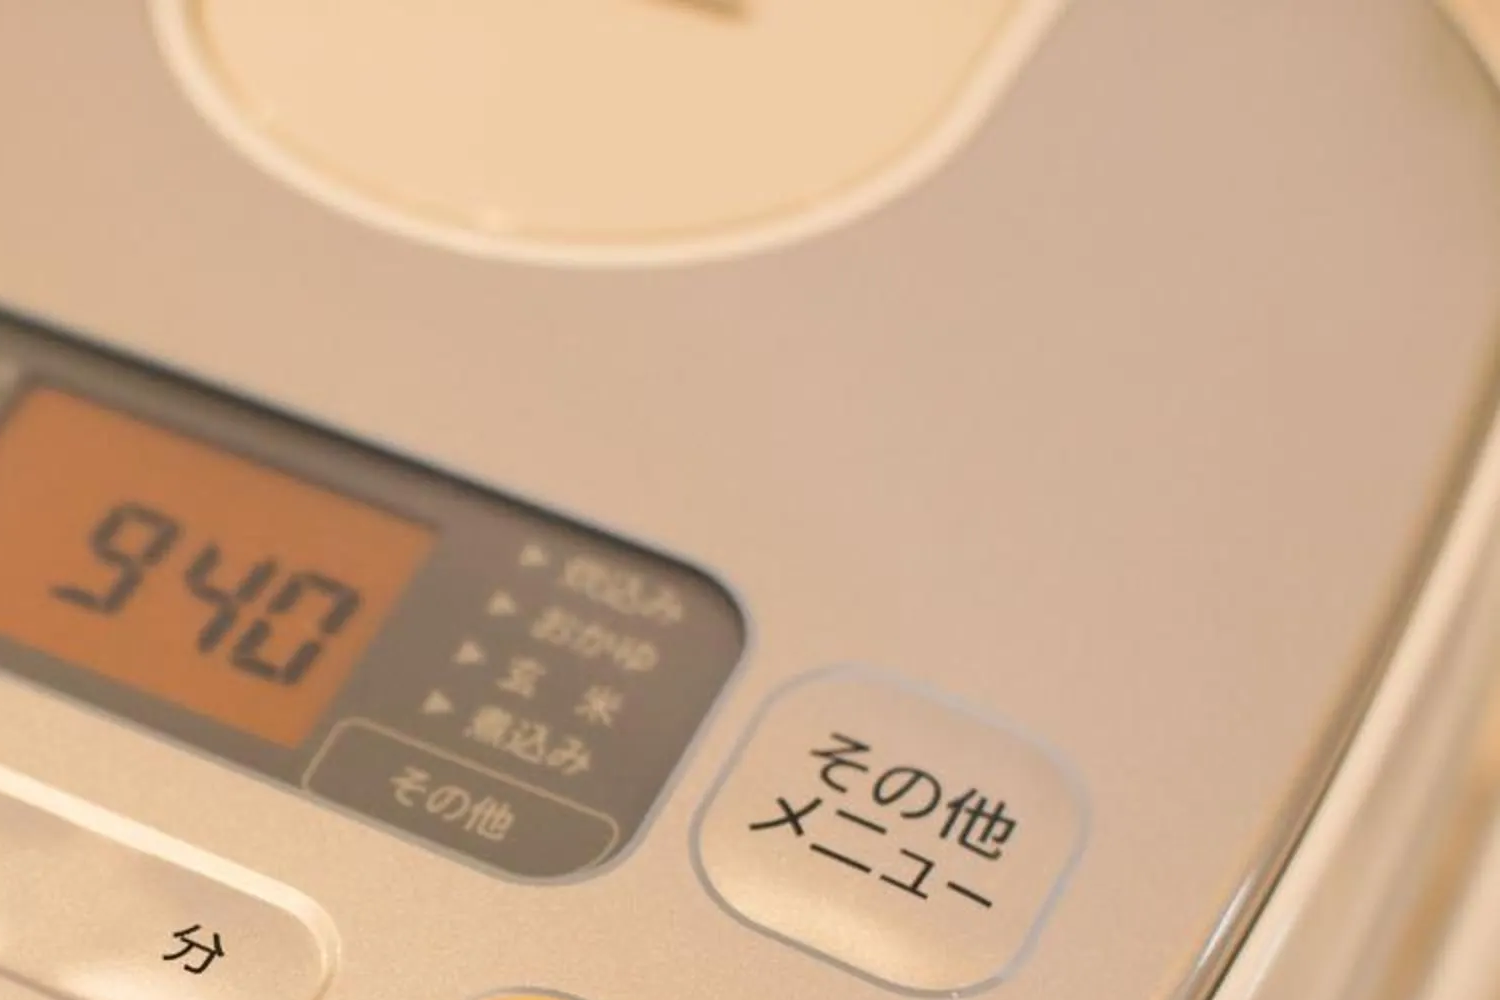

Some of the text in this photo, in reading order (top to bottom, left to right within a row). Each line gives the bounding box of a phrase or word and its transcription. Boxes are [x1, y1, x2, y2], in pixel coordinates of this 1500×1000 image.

[49, 501, 361, 685] 940
[529, 607, 659, 671] おかゆ
[389, 765, 515, 841] その他
[810, 732, 1017, 861] その他
[748, 798, 992, 908] メニュー
[162, 922, 226, 975] 分
